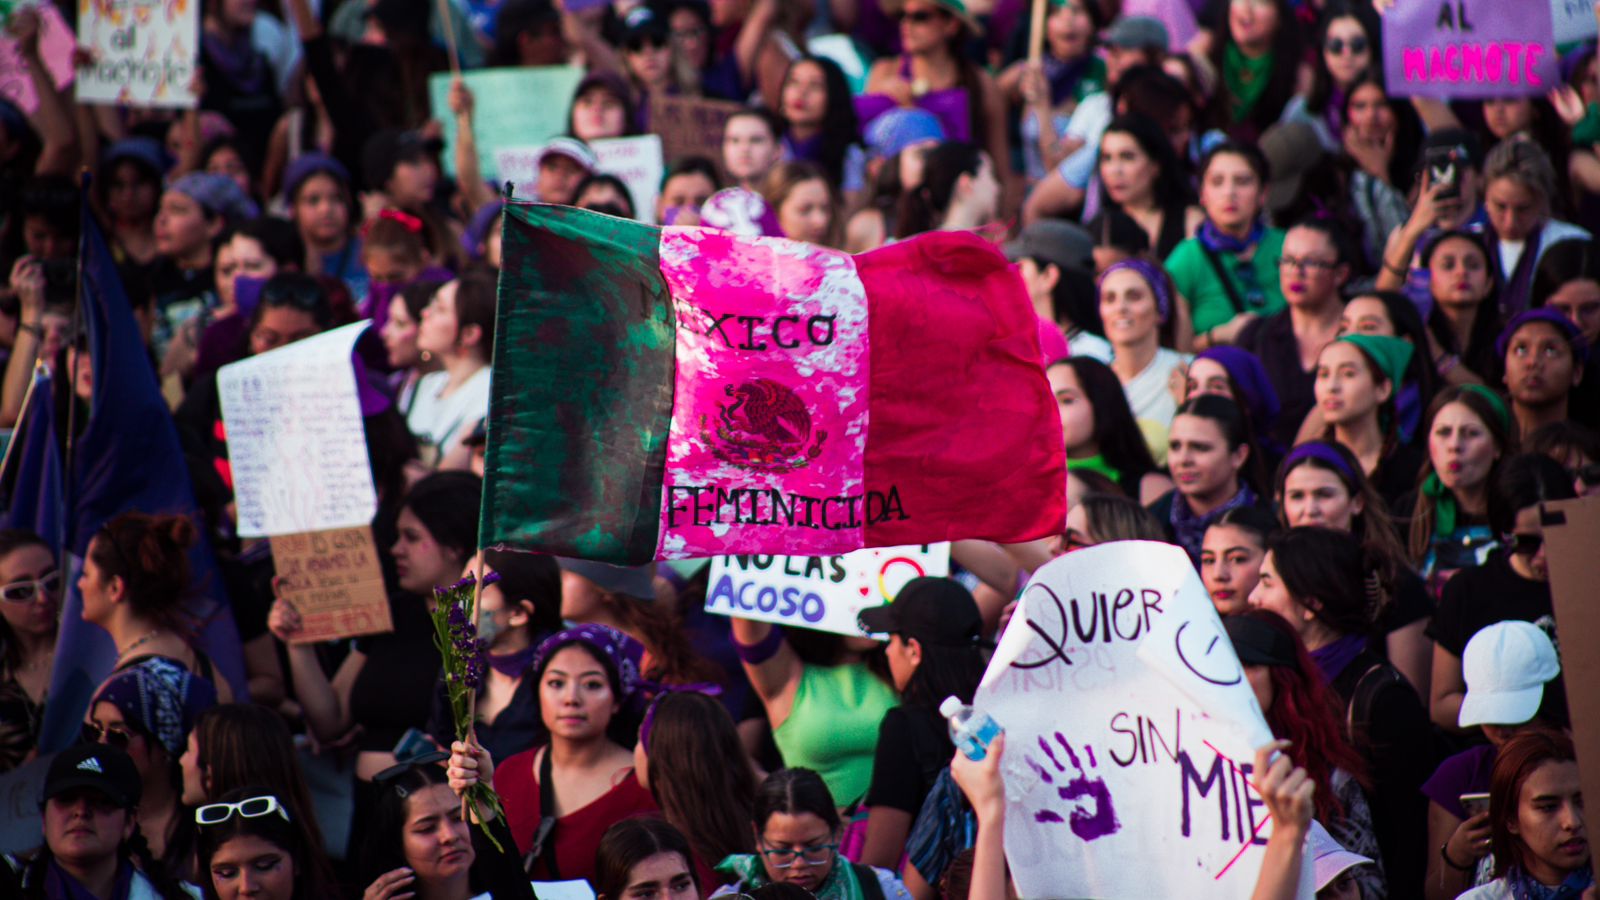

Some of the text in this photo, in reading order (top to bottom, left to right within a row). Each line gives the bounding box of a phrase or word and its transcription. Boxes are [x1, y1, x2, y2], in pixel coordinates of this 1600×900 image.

[1436, 2, 1473, 32] AL
[667, 485, 911, 530] FEMINICIDA
[784, 554, 846, 583] LAS
[706, 574, 826, 623] ACOSO
[1009, 582, 1179, 669] QUIER
[1109, 708, 1180, 767] SIN
